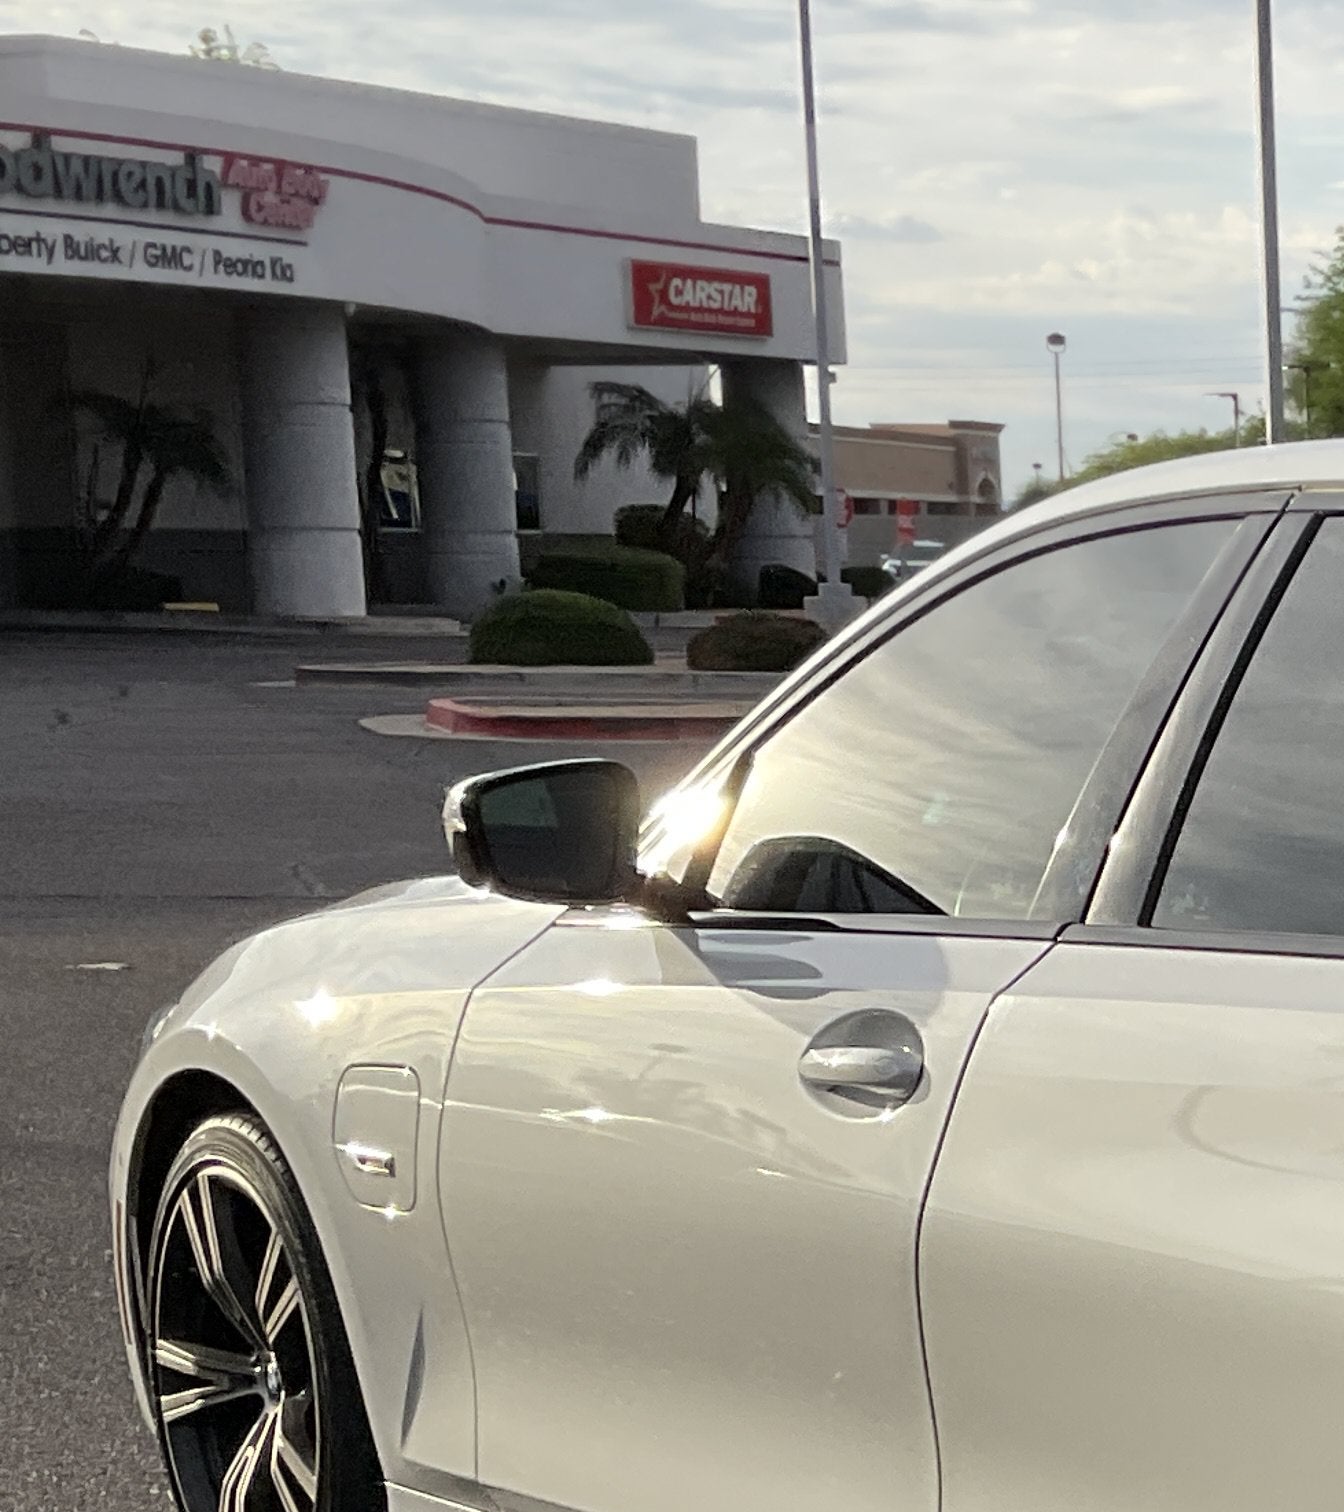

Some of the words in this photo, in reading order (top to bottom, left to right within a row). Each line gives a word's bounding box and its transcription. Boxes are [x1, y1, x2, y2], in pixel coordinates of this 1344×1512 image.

[63, 233, 122, 264] Buick
[143, 241, 194, 272] GMC
[212, 247, 266, 280] Peoria
[269, 255, 295, 283] Kia
[668, 276, 757, 314] CARSTAR
